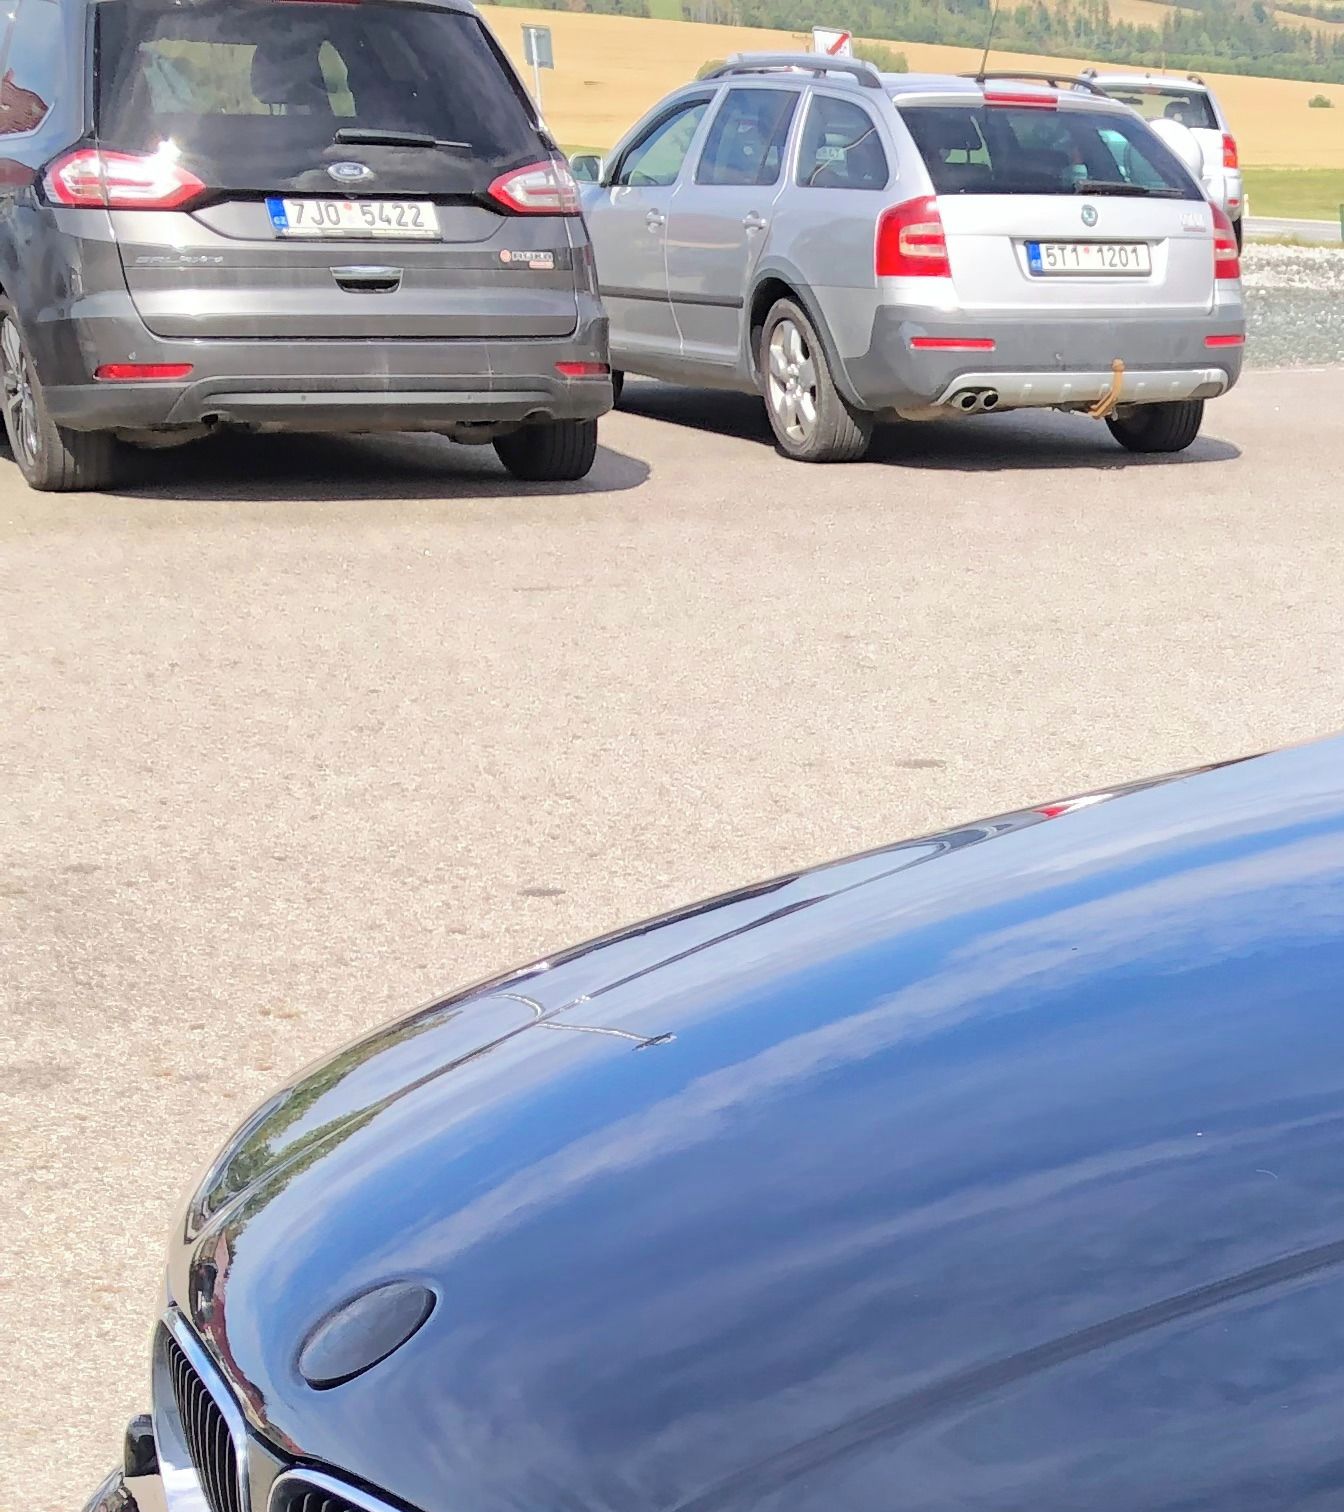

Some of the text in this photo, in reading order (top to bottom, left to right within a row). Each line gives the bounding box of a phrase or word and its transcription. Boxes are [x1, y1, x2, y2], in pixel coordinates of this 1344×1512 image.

[290, 201, 425, 228] 7J0 5422
[1045, 245, 1140, 268] 5T1 1201
